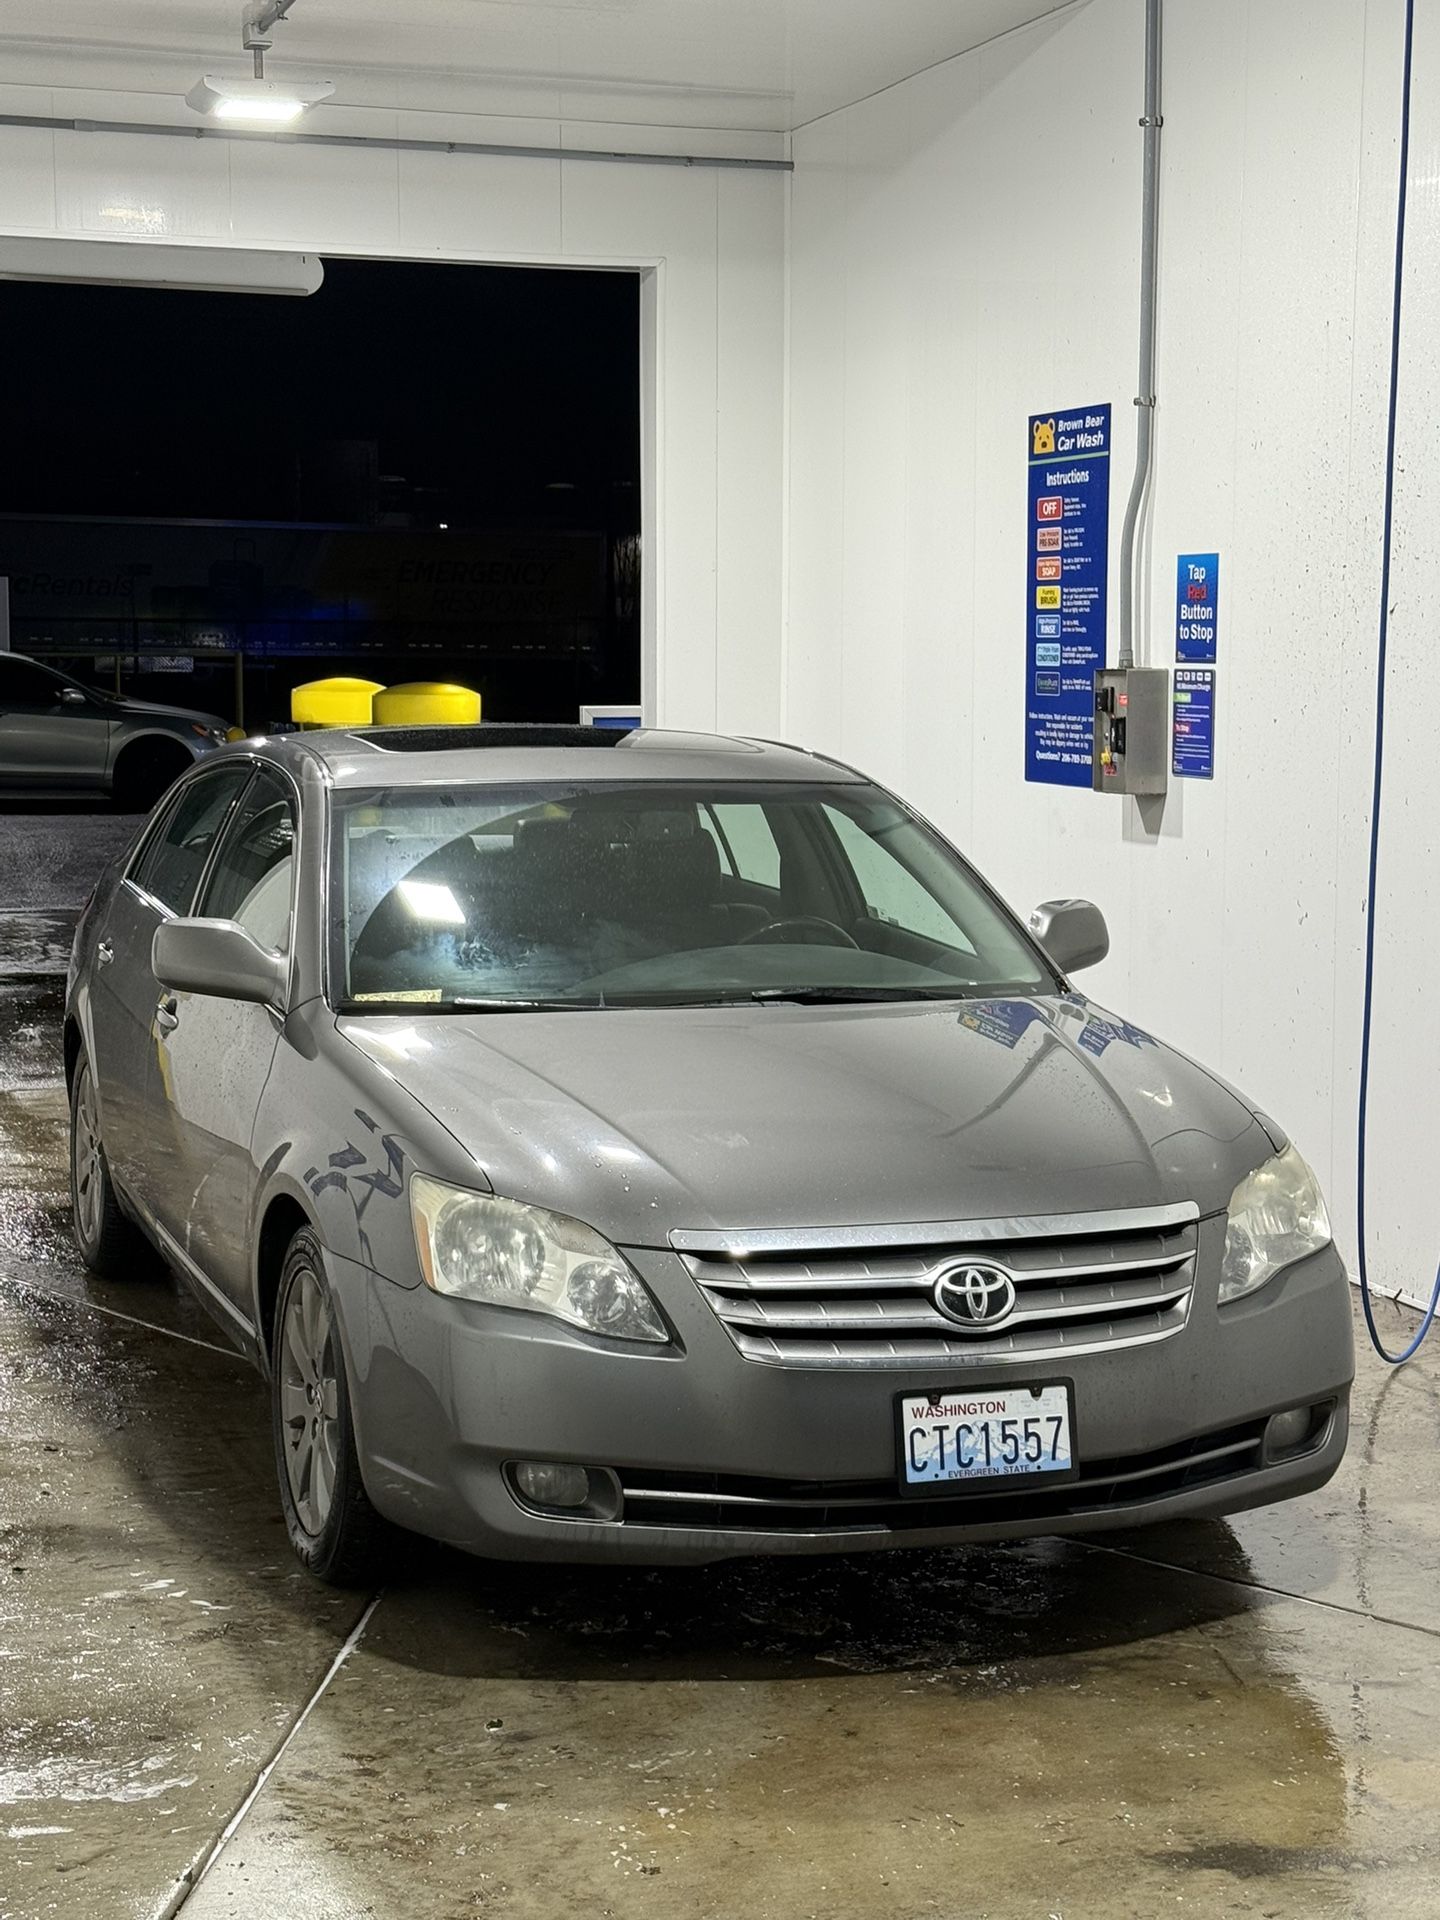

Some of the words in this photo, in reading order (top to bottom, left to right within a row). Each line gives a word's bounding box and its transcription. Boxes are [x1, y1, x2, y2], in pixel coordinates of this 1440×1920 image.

[1058, 420, 1083, 432] Brown
[1085, 416, 1104, 428] Bear
[1058, 436, 1075, 451] Car
[1077, 430, 1104, 448] Wash
[1046, 468, 1089, 487] Instructions
[1043, 501, 1057, 515] OFF
[399, 560, 556, 585] EMERGENCY
[1042, 567, 1056, 576] SOAP
[1187, 563, 1206, 583] Tap
[1187, 584, 1208, 600] Red
[1040, 596, 1058, 605] BRUSH
[1180, 603, 1213, 620] Button
[1041, 625, 1057, 634] RINSE
[1179, 624, 1189, 640] to
[1190, 623, 1213, 644] Stop
[1035, 750, 1061, 761] Questions?
[911, 1401, 1007, 1419] WASHINGTON
[909, 1415, 1063, 1473] CTC1557
[947, 1466, 1000, 1479] EVERGREEN
[1003, 1465, 1030, 1474] STATE
